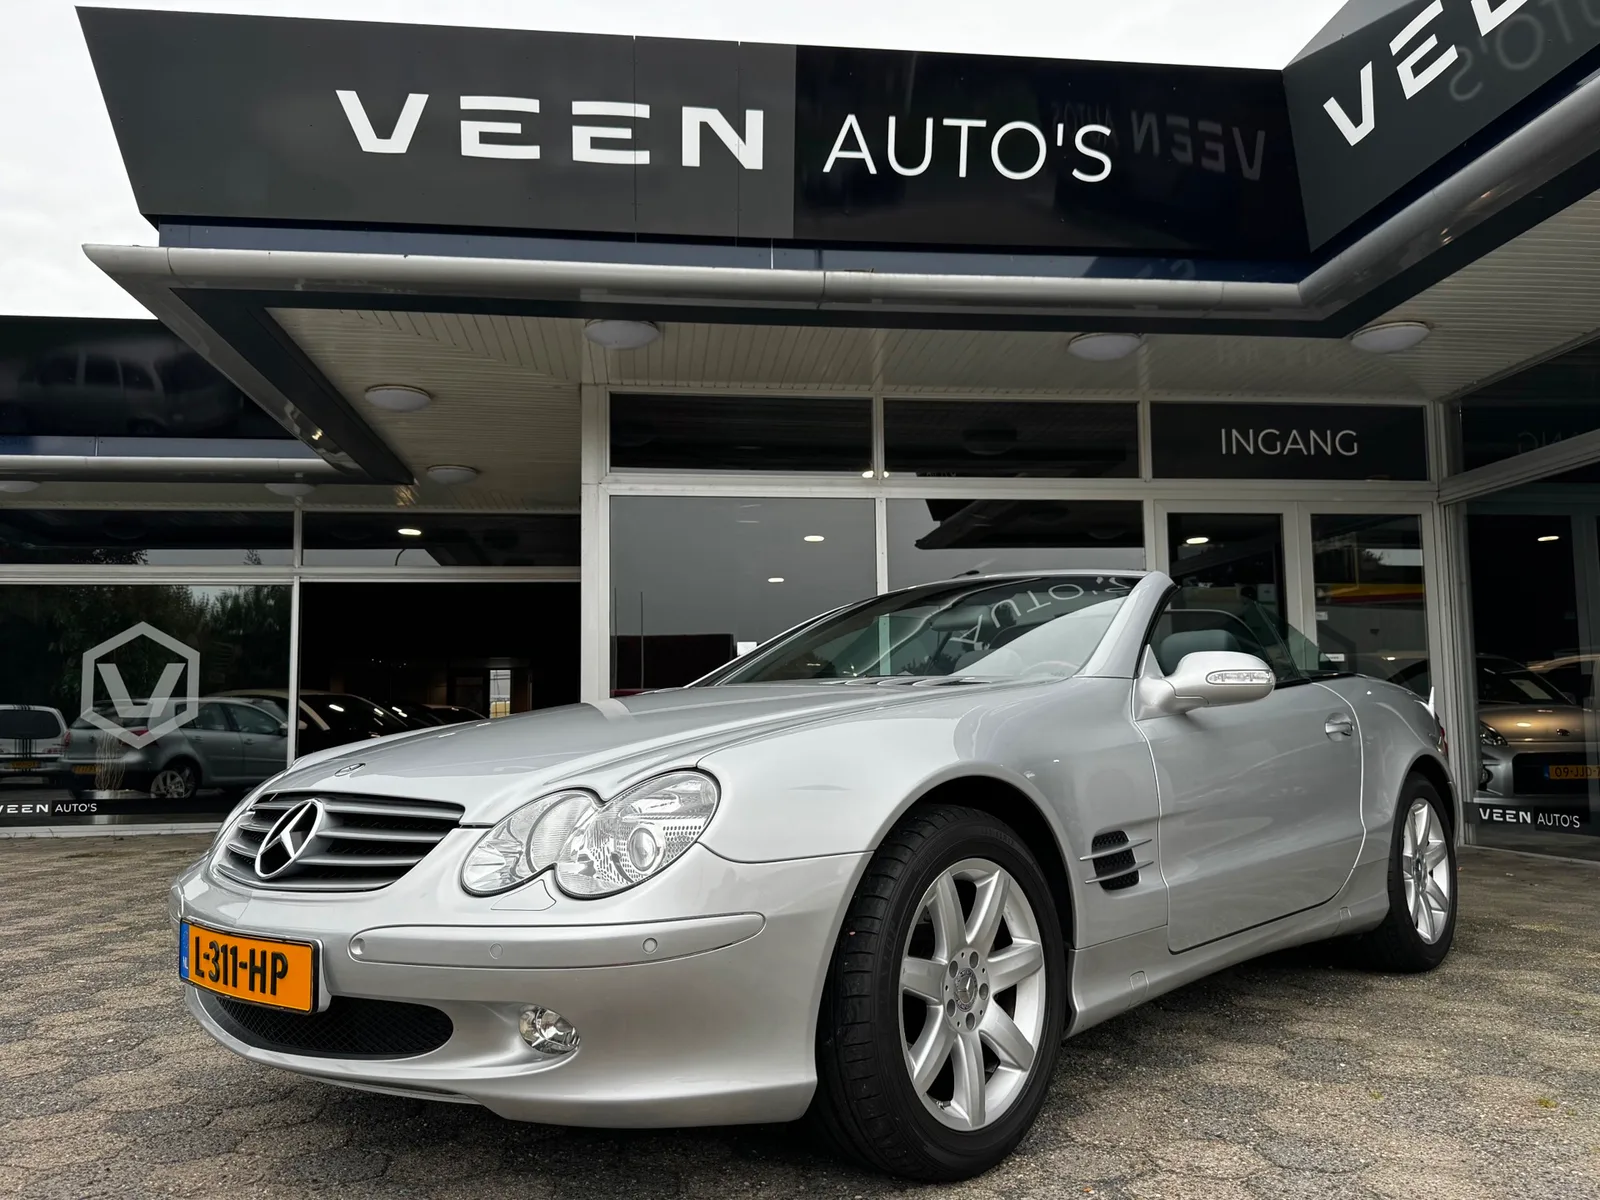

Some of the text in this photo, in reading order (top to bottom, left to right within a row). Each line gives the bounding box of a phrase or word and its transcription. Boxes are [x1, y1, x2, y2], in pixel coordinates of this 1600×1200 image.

[335, 89, 1113, 183] VEEN AUTO'S
[1220, 428, 1359, 456] INGANG
[96, 662, 187, 718] V
[54, 803, 97, 813] AUTO'S
[1479, 807, 1581, 828] VEEN AUTO'S
[194, 935, 289, 997] L-311-HP
